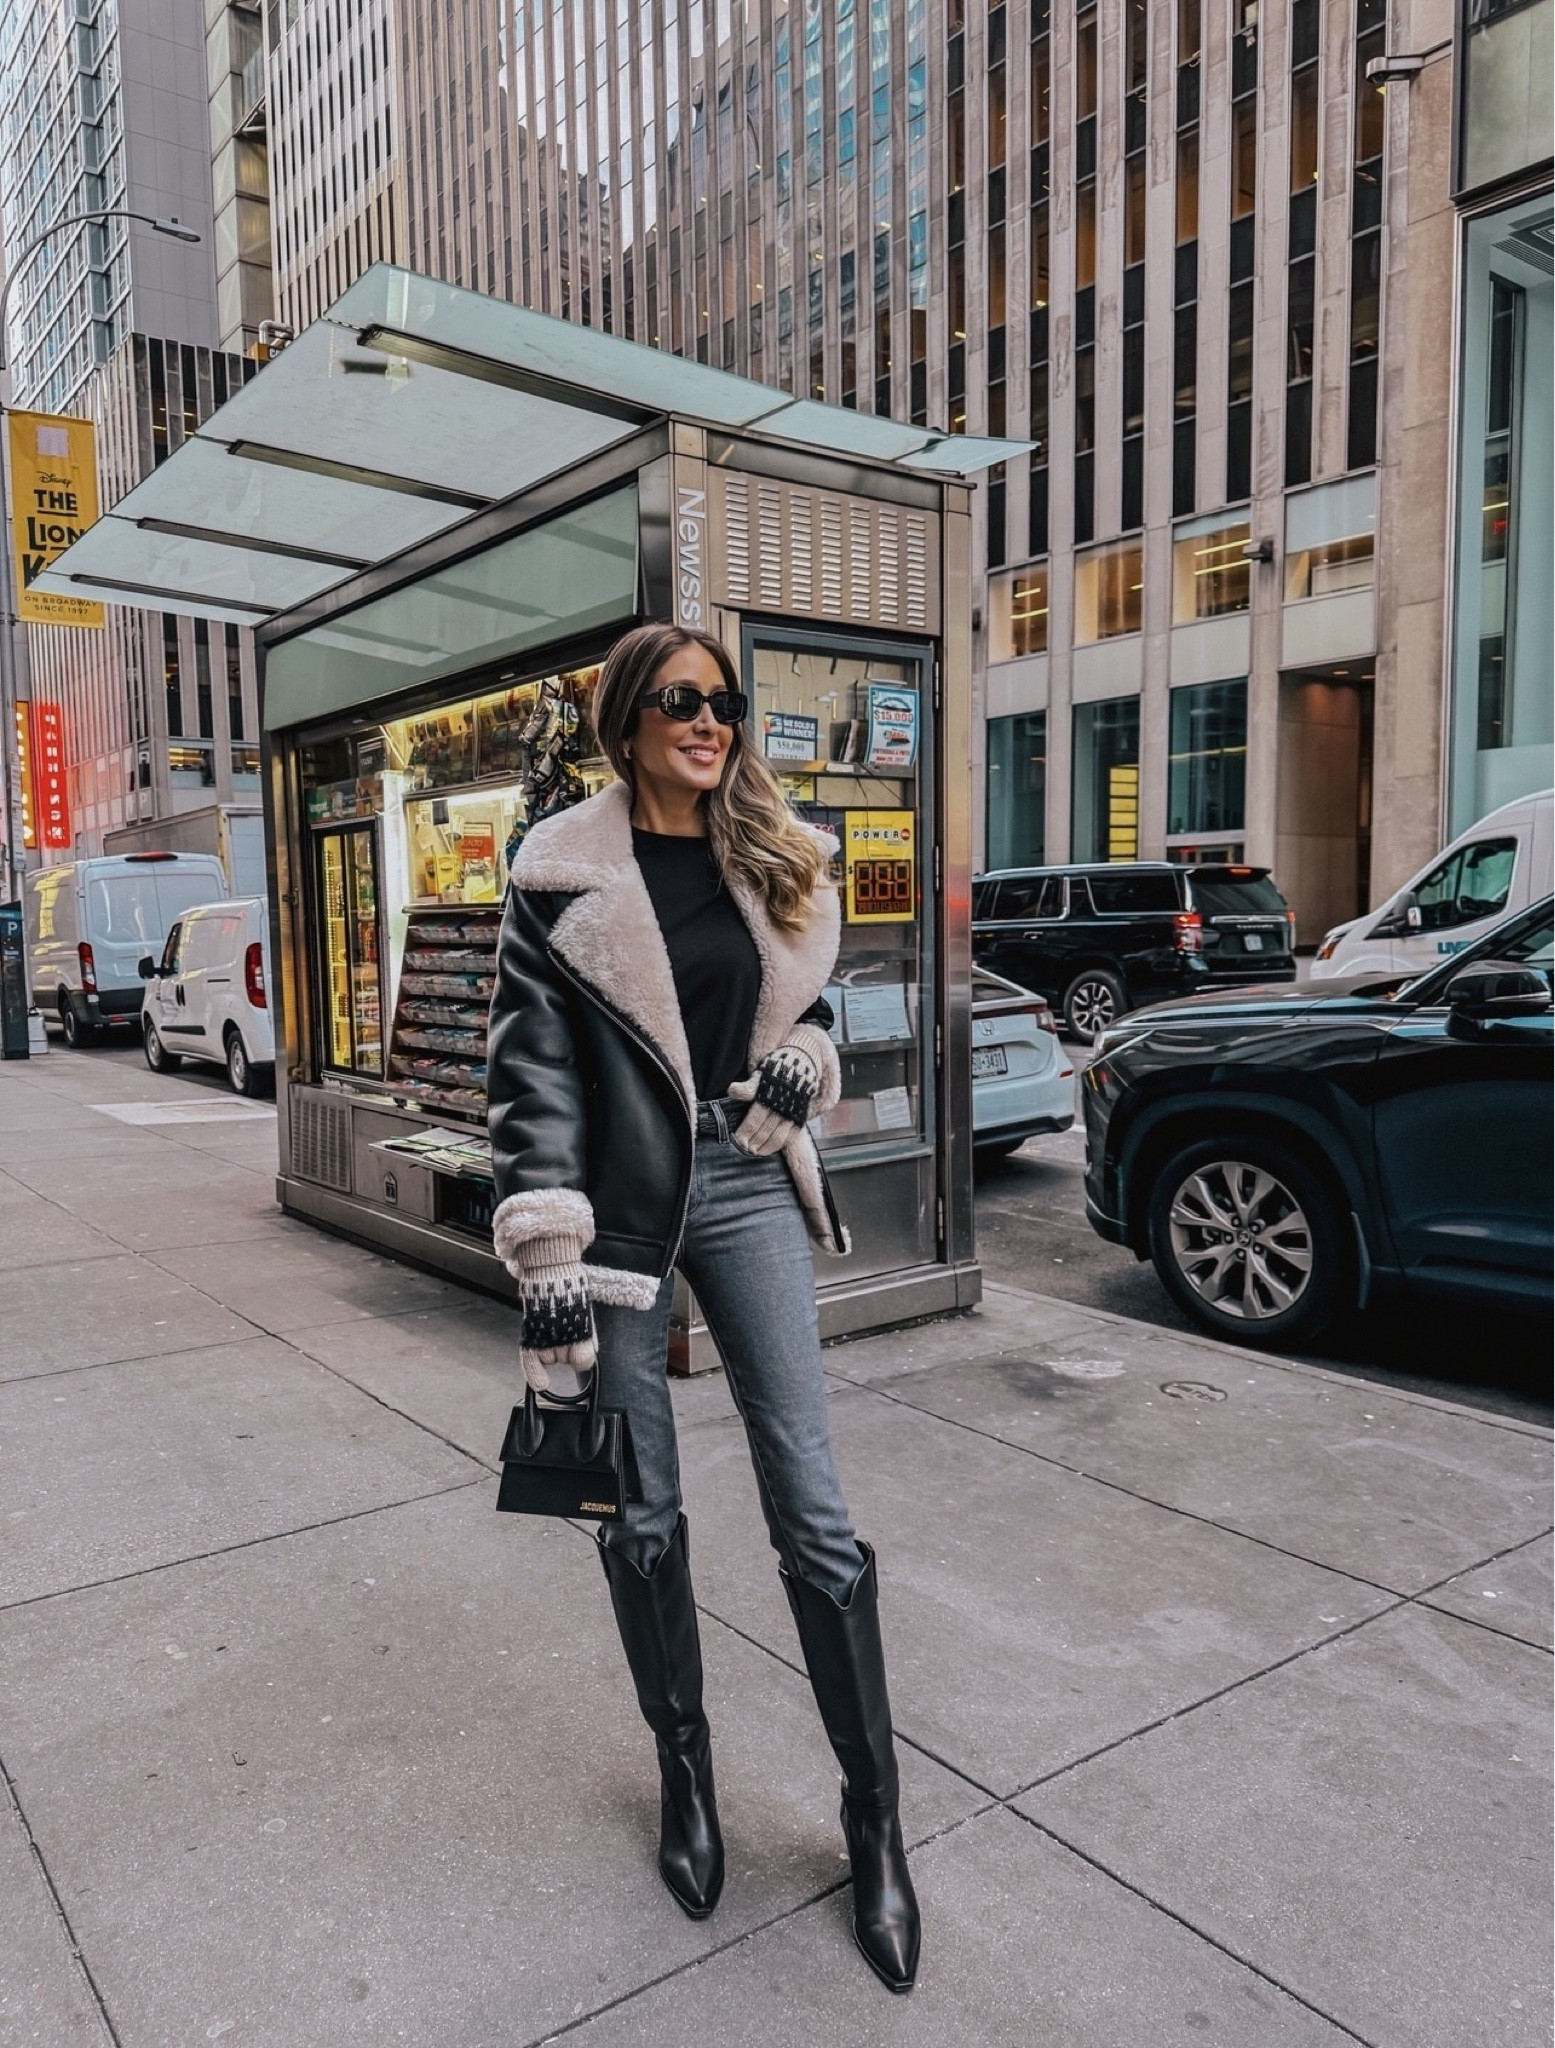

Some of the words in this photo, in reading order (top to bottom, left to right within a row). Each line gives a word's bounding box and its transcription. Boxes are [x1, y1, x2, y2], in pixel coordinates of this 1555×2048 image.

[36, 471, 73, 488] Disney
[33, 489, 79, 512] THE
[27, 516, 85, 551] LION
[678, 487, 706, 628] Newss
[24, 595, 38, 603] ON
[42, 596, 97, 608] BROADWAY
[34, 604, 64, 613] SINCE
[68, 607, 88, 615] 1997
[852, 830, 899, 840] POWER
[7, 921, 18, 936] P
[580, 1501, 617, 1514] JACQUEMUS
